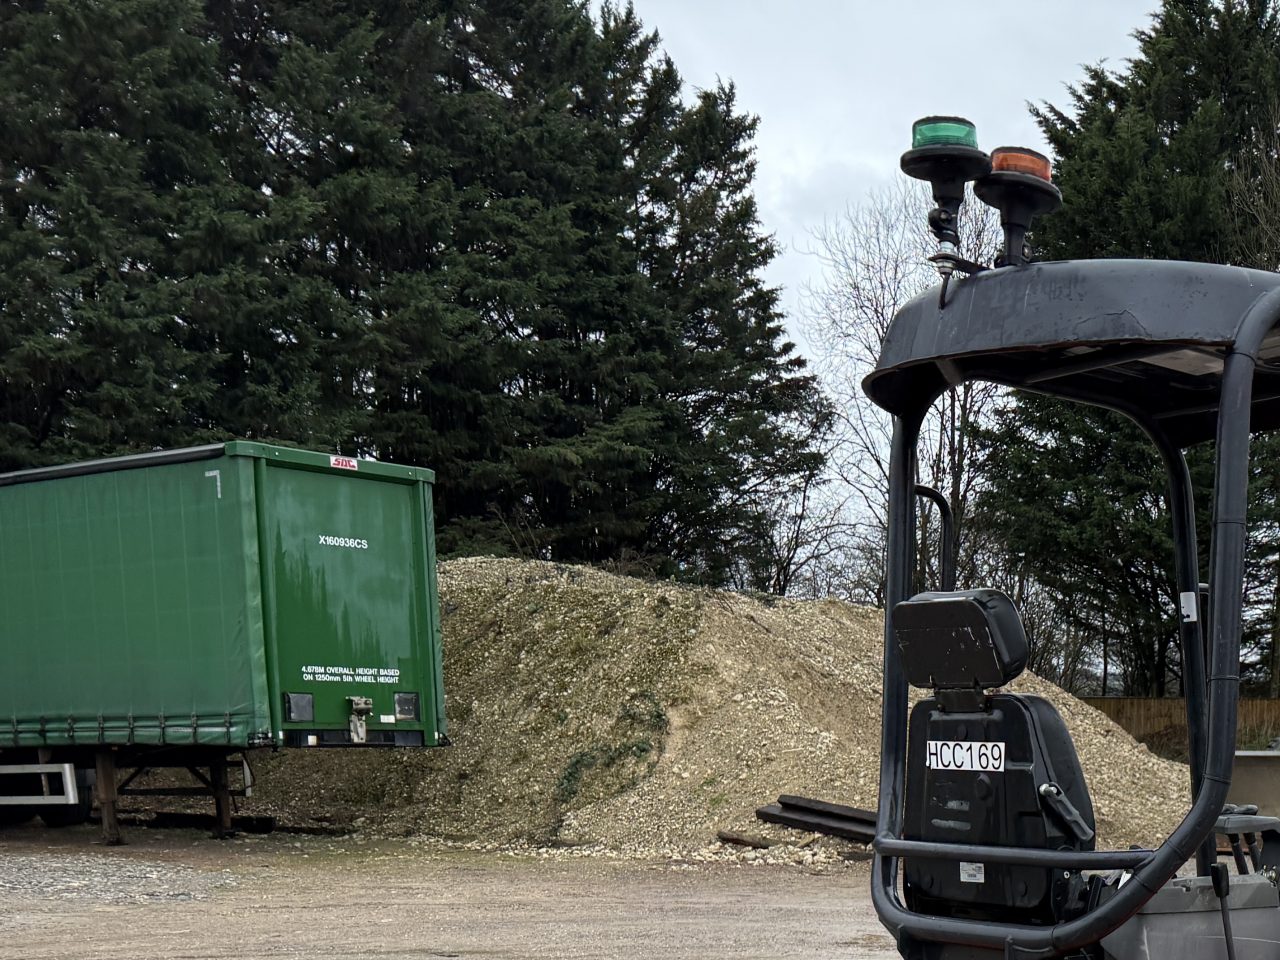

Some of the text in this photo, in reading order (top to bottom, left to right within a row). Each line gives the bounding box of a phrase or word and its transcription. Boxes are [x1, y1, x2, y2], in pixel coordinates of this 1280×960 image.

[318, 534, 369, 549] X160936CS
[326, 666, 355, 675] OVERALL
[355, 667, 378, 675] HEIGHT
[379, 668, 400, 676] BASED
[303, 673, 313, 681] ON
[315, 674, 341, 682] 1250mm
[354, 675, 376, 683] WHEEL
[377, 676, 399, 684] HEIGHT
[927, 742, 1003, 770] HCC169
